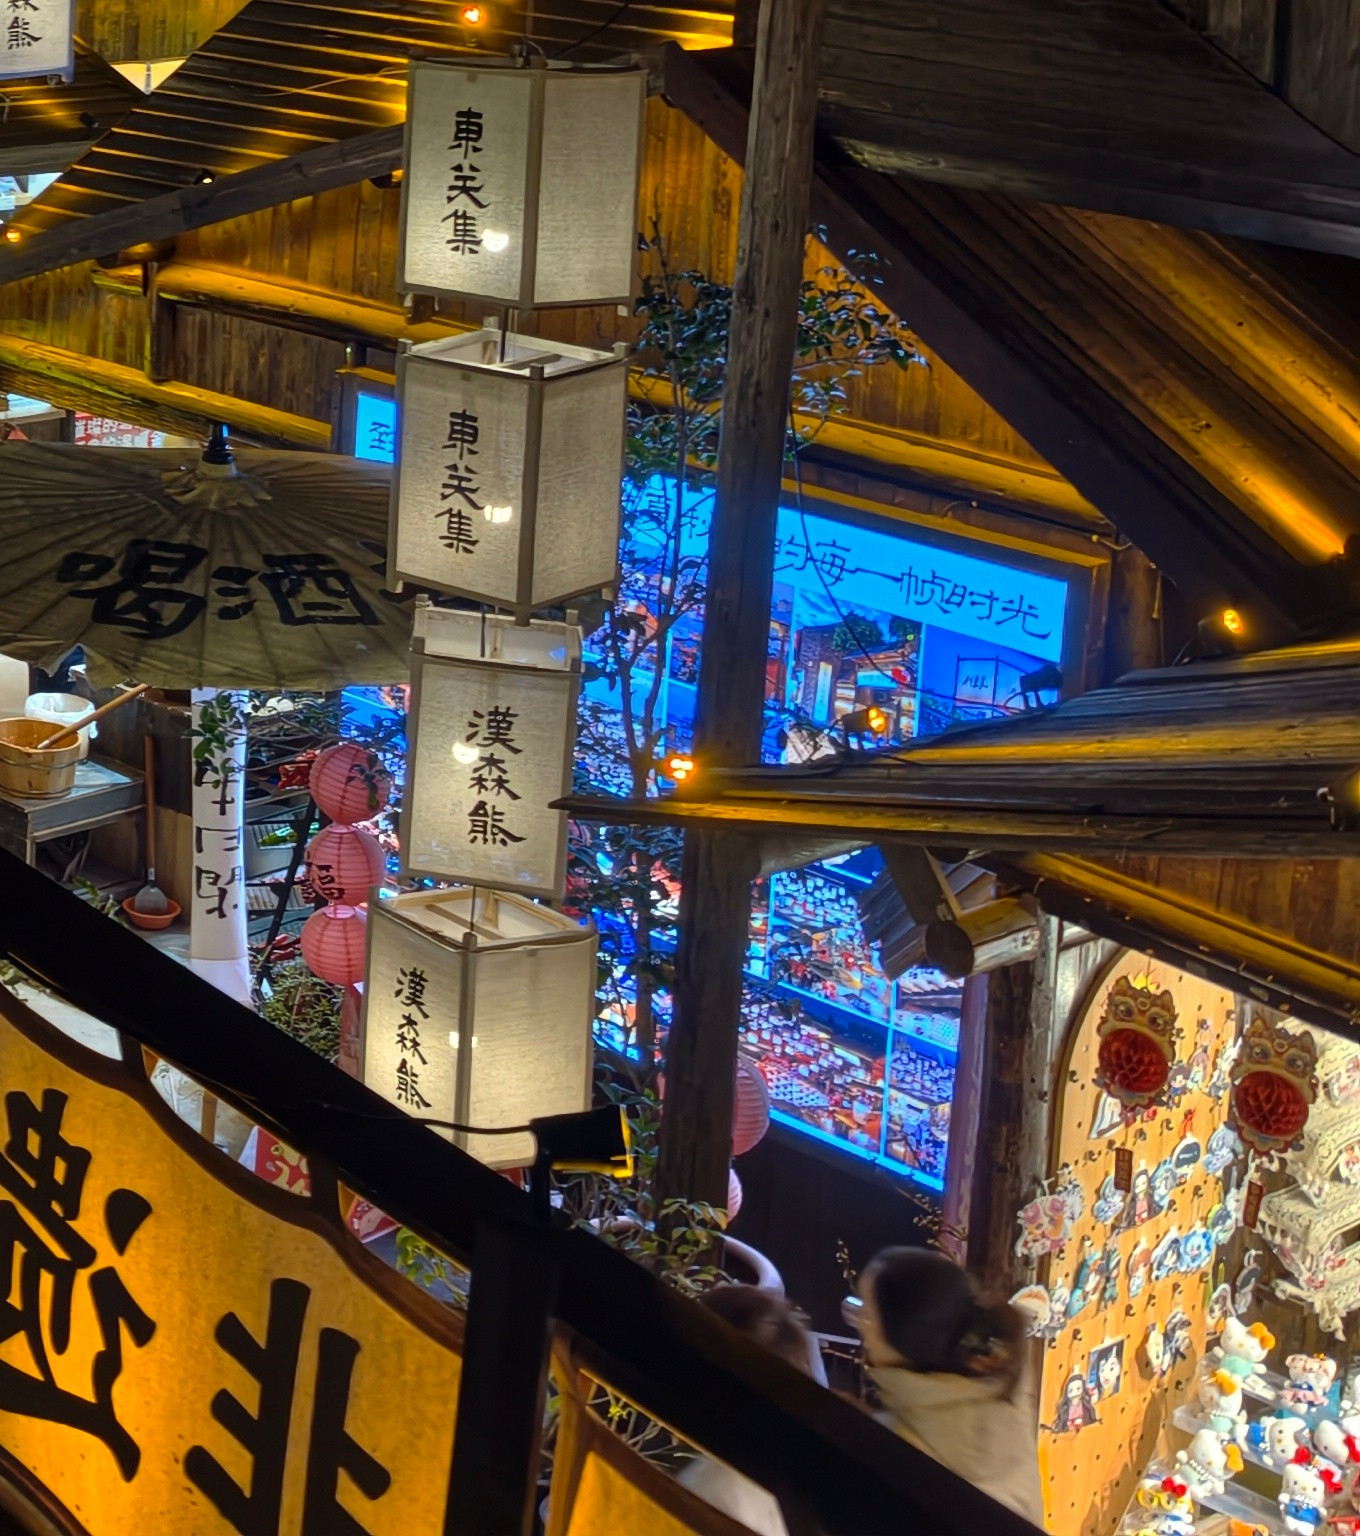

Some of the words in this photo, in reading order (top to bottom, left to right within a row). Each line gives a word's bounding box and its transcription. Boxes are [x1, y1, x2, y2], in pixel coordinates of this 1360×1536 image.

[56, 538, 420, 640] 喝酒
[464, 704, 527, 848] 漢森熊
[393, 966, 433, 1112] 漢森熊
